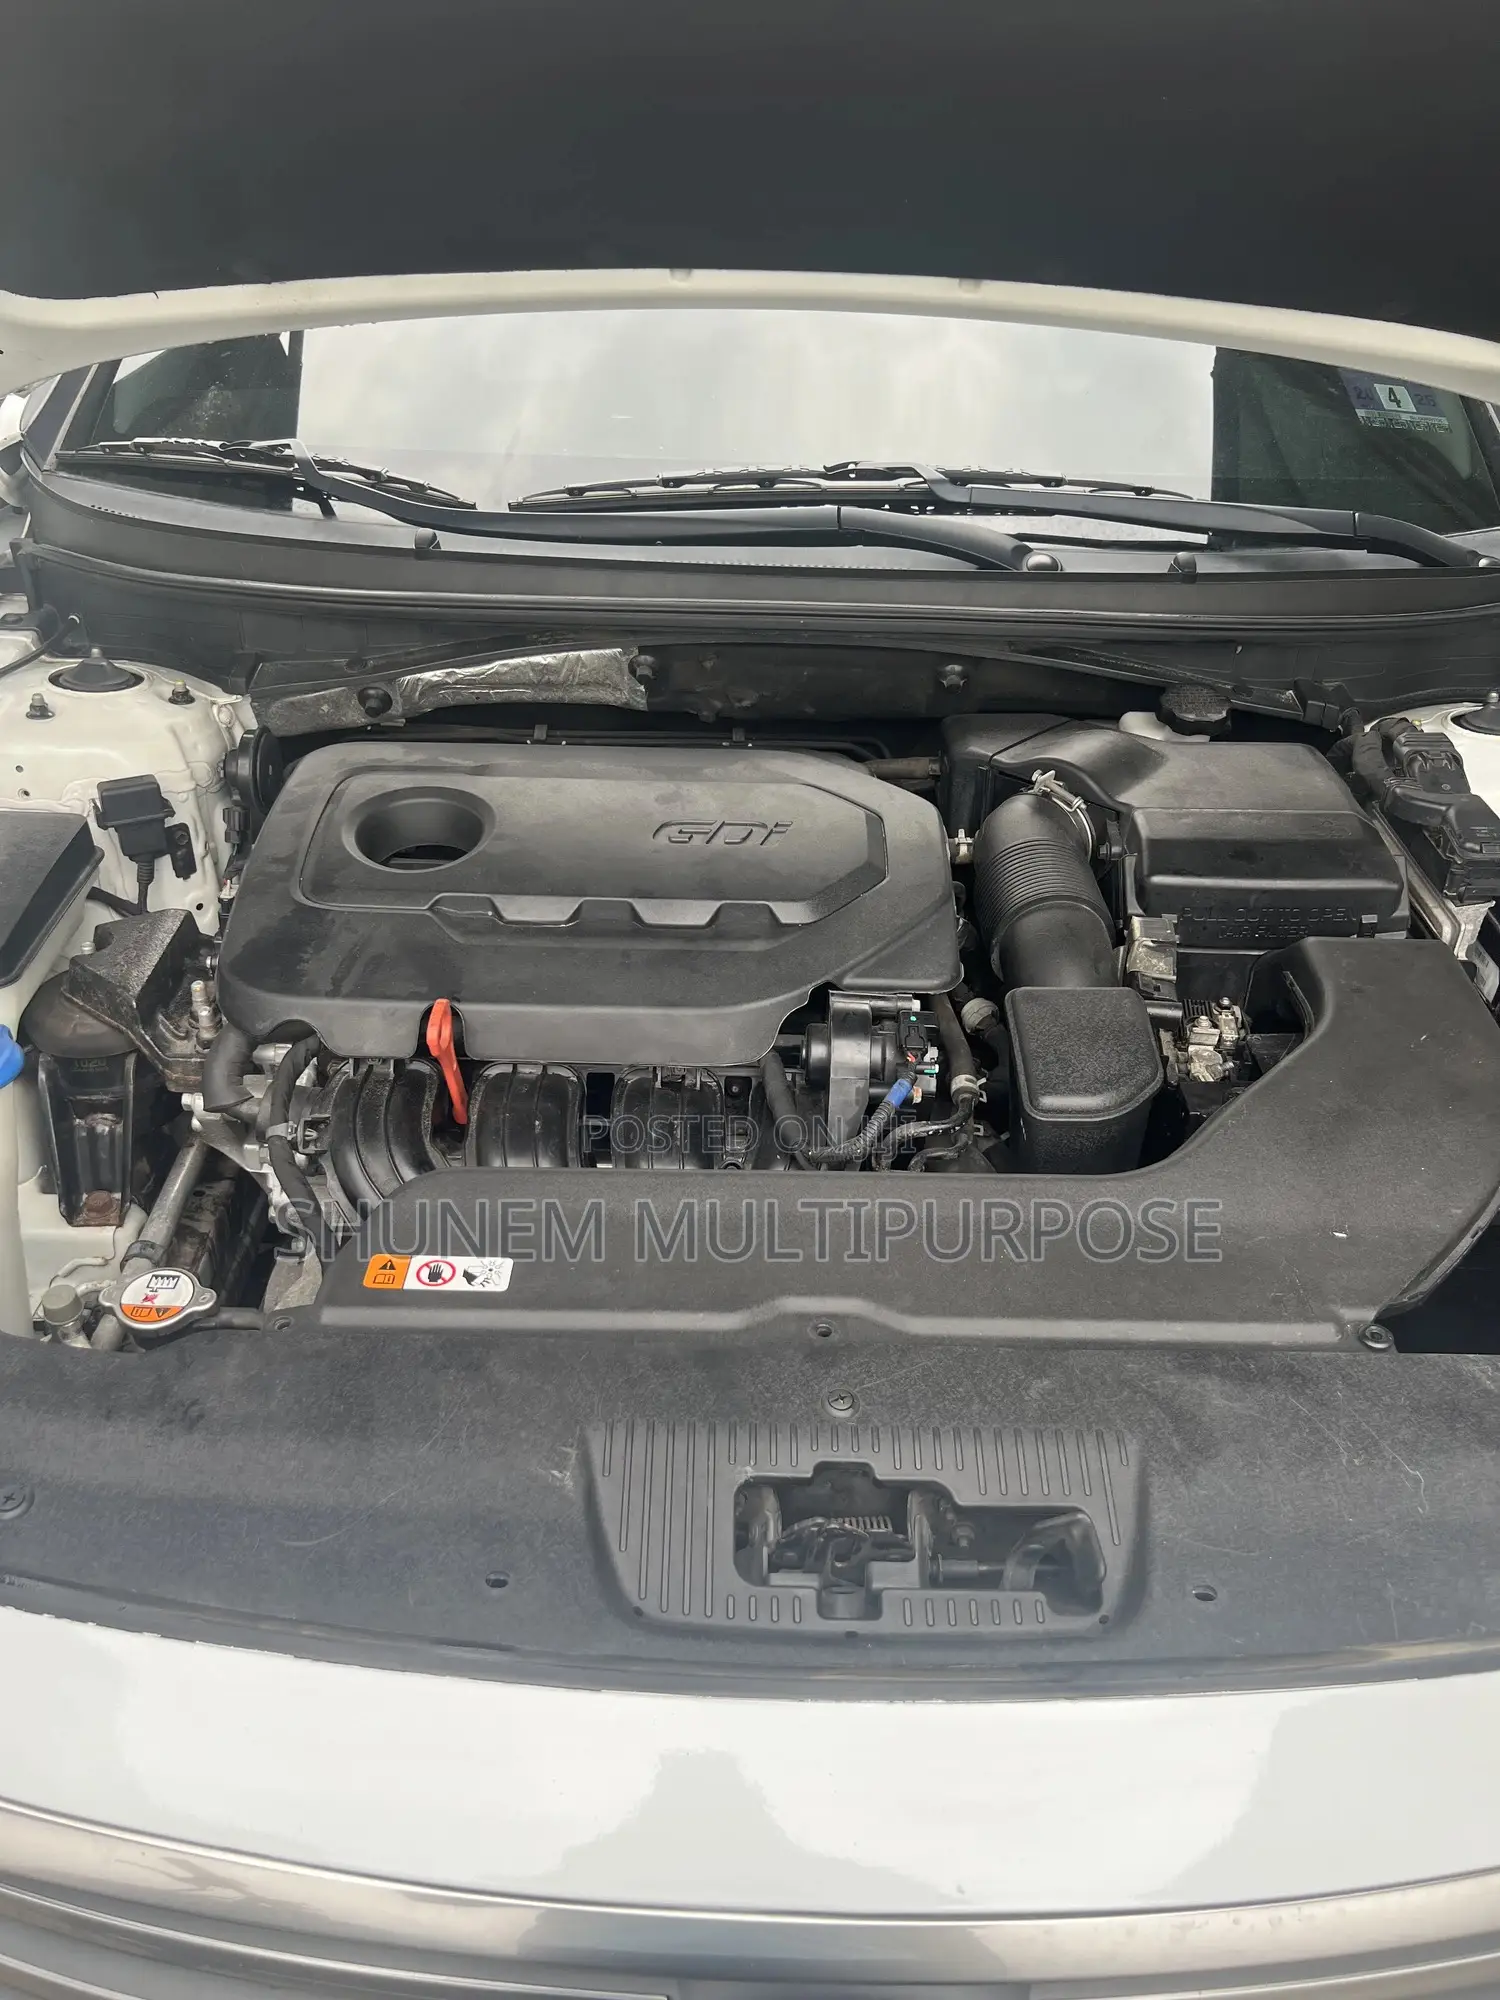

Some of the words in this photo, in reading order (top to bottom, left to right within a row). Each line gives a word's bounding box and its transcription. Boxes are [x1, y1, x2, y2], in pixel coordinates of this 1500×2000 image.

[1388, 387, 1402, 408] 4
[1179, 907, 1228, 922] PULL
[1234, 907, 1275, 922] OUT
[1278, 907, 1300, 922] TO
[1307, 907, 1357, 922] OPEN
